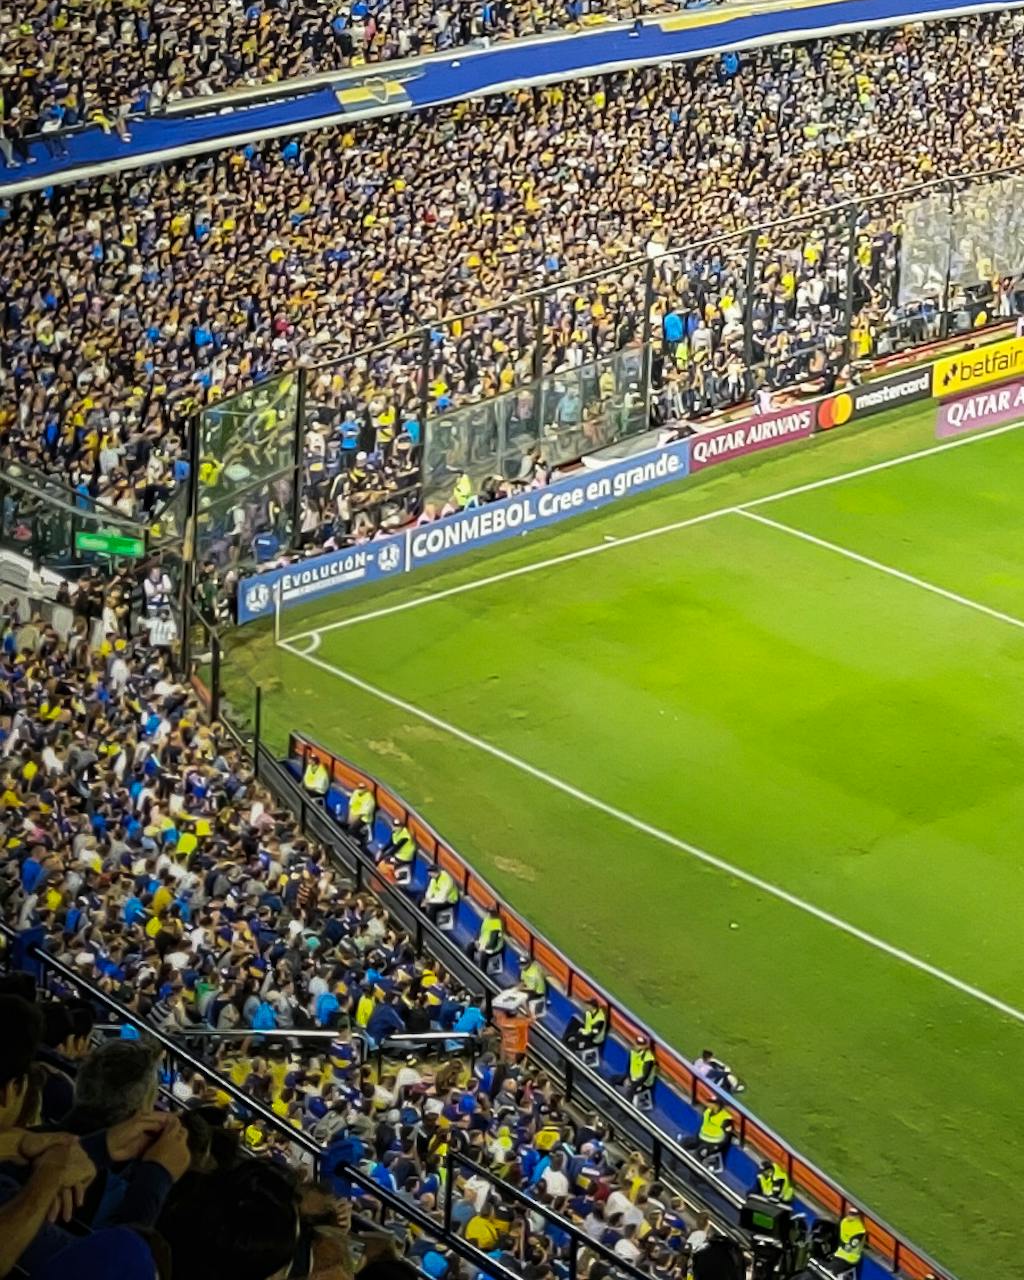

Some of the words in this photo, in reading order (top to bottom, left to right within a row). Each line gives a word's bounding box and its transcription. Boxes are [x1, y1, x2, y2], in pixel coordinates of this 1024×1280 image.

[855, 372, 930, 411] mastercard
[946, 390, 1010, 427] QATAR
[692, 431, 745, 464] QATAR
[746, 409, 811, 445] AIRWAYS
[411, 500, 537, 558] CONMEBOL
[538, 492, 583, 519] Cree
[586, 479, 610, 500] en
